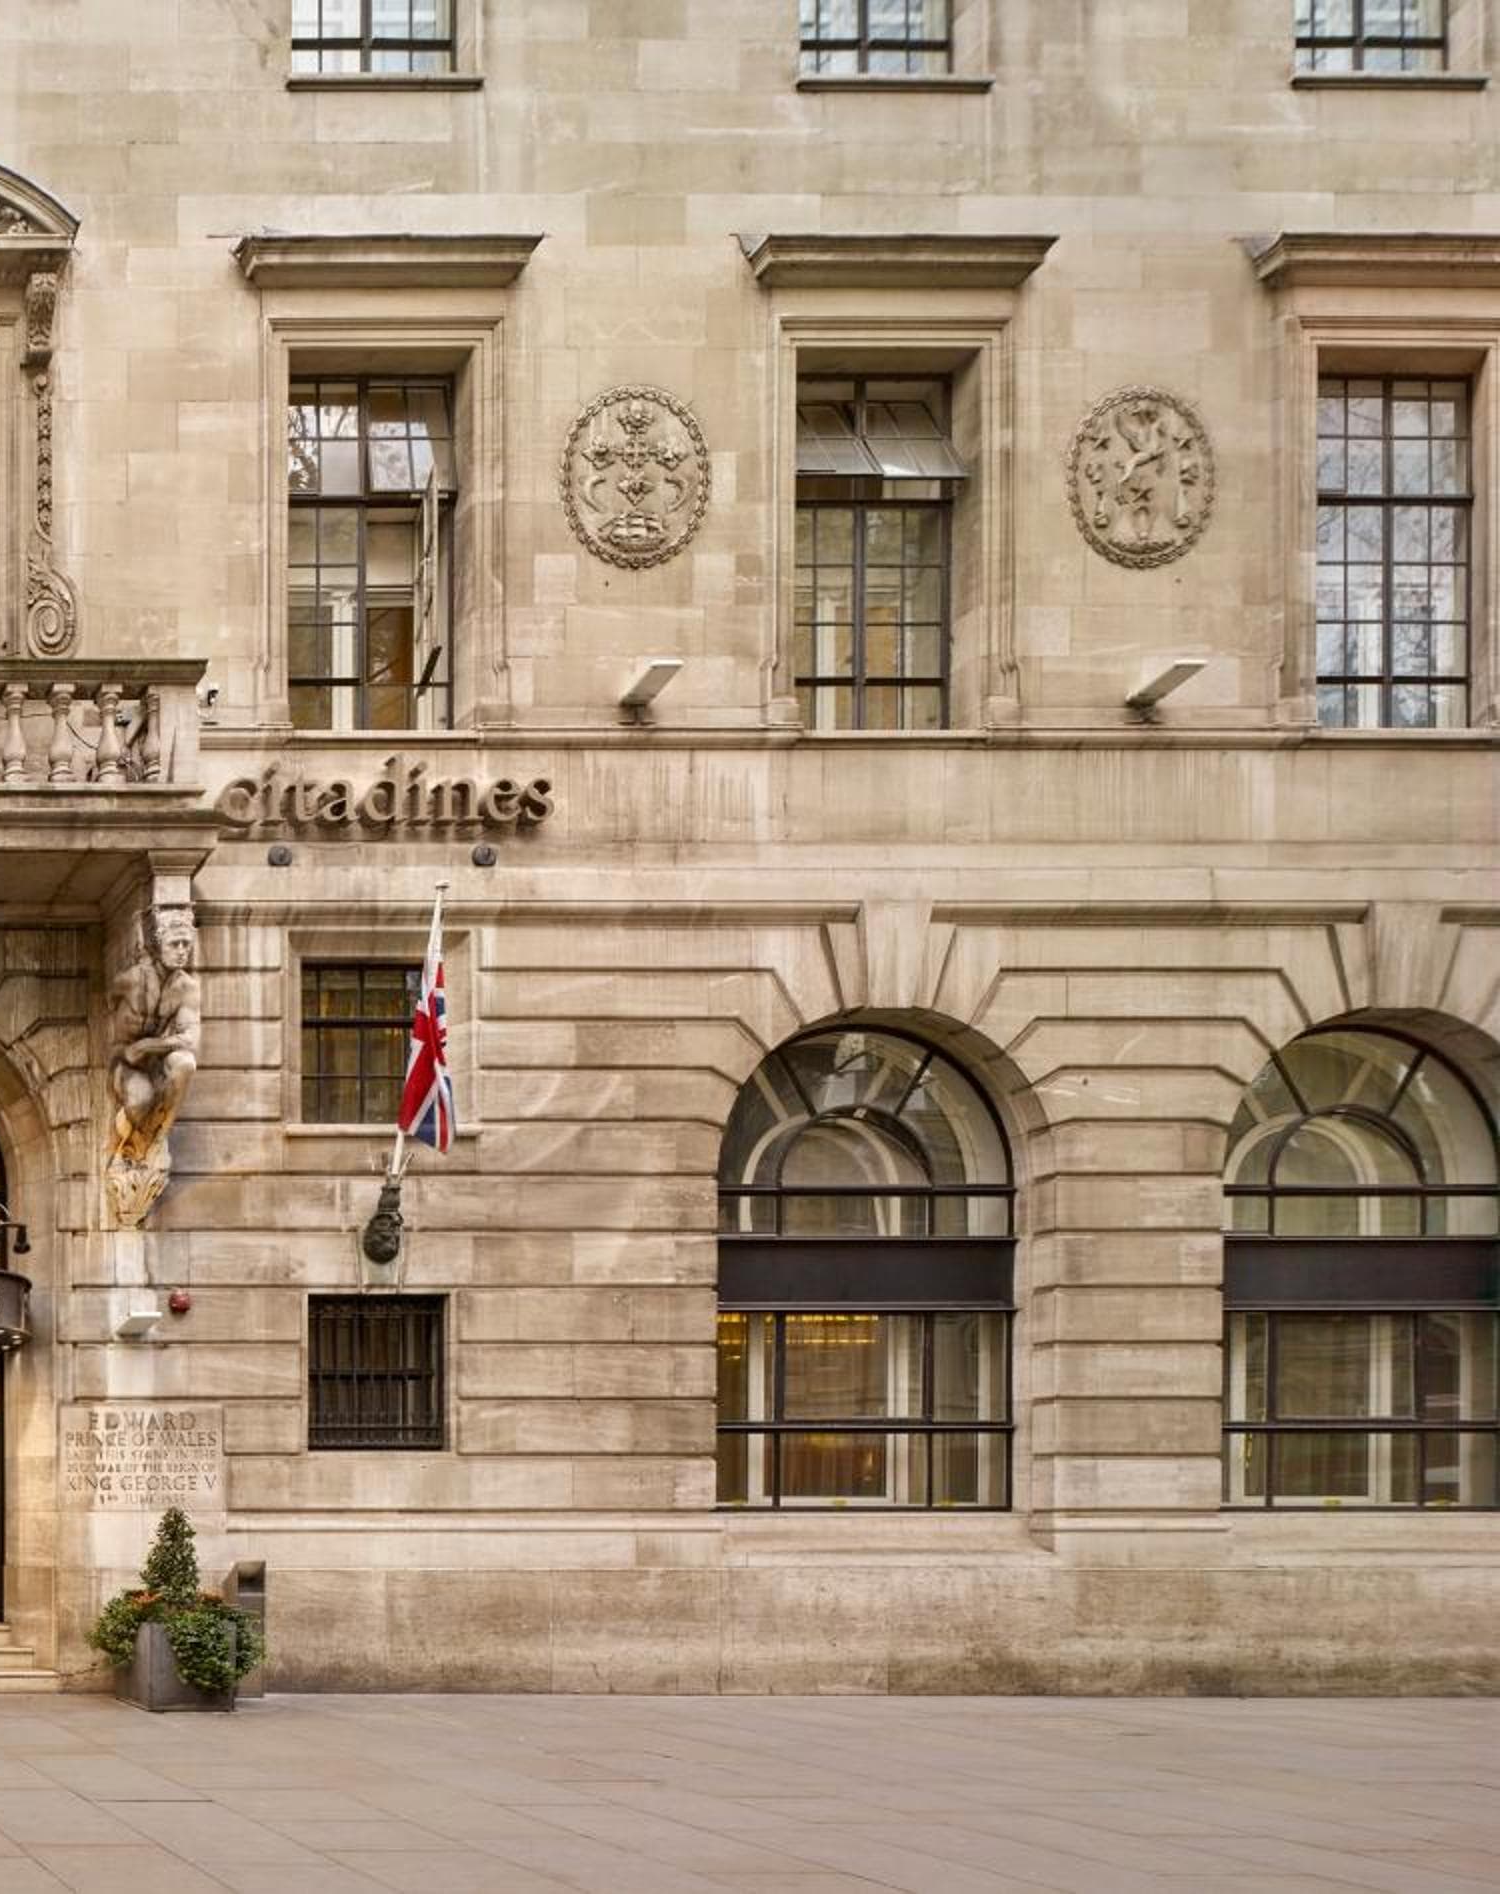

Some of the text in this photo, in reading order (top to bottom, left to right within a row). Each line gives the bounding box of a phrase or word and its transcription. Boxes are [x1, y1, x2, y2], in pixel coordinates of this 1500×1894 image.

[214, 753, 554, 828] citadines
[88, 1411, 197, 1431] EDWARD
[65, 1431, 218, 1447] PRINCE OF WALES
[66, 1475, 217, 1491] KING GEORGE V
